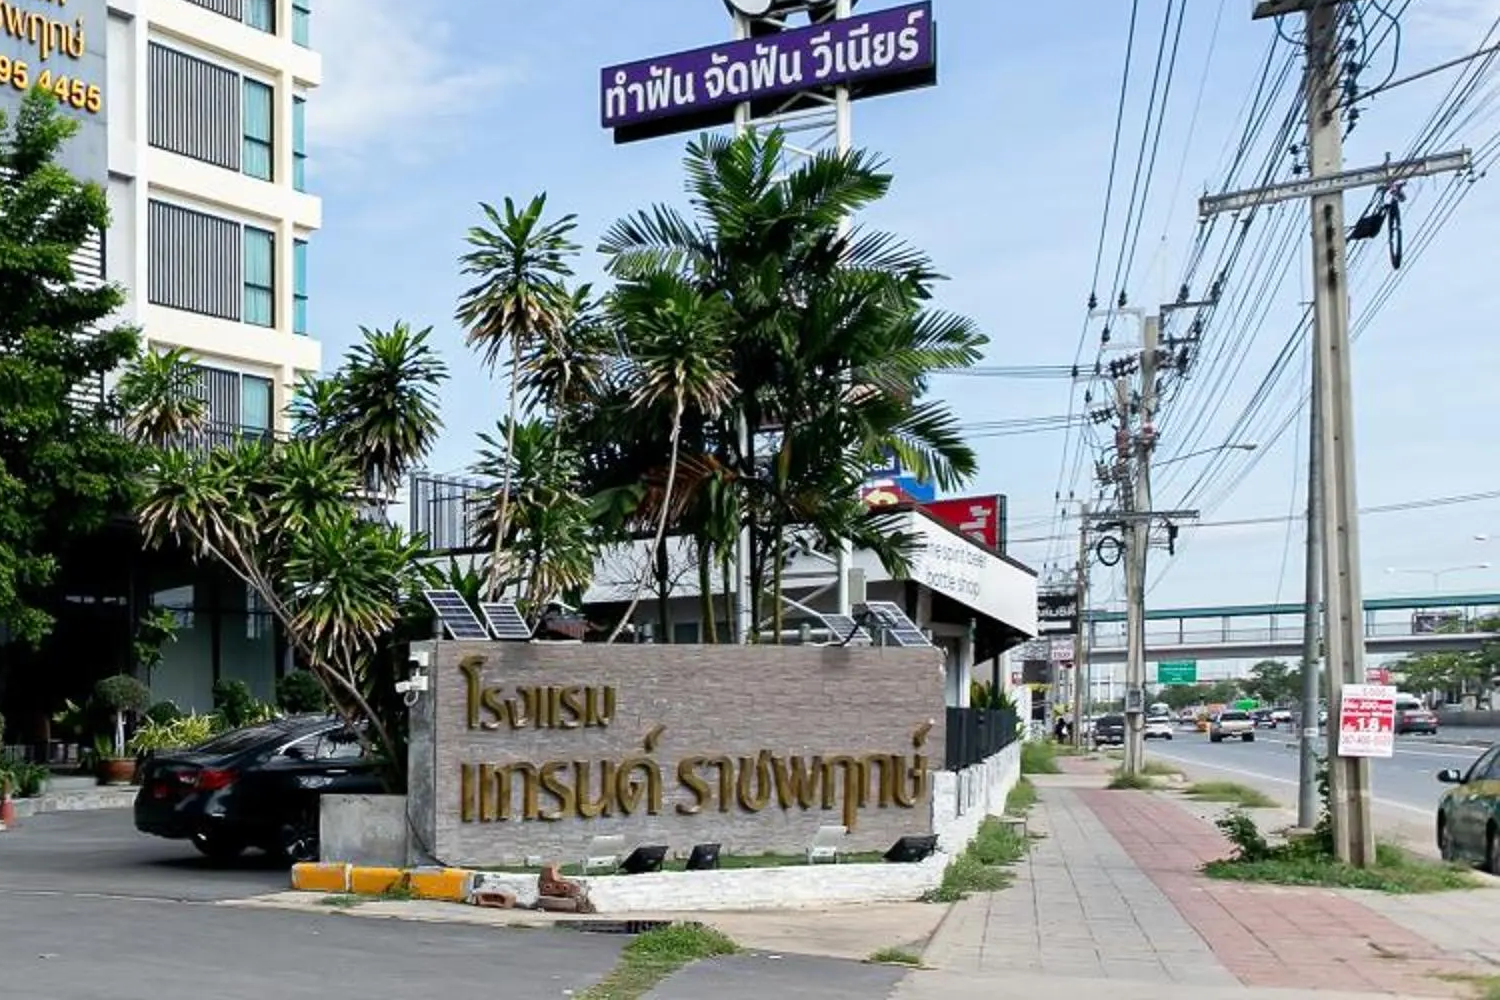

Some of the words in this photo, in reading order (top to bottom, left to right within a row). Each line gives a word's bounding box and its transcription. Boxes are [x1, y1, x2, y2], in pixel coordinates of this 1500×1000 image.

[38, 68, 101, 113] 4455
[604, 64, 696, 120] ทำฟัน
[704, 42, 802, 100] จัดฟัน
[810, 10, 925, 80] วีเนียร์
[457, 654, 617, 730] โรงแรม
[461, 723, 666, 824] แกรนด์
[676, 718, 935, 834] ราชพฤกษ์
